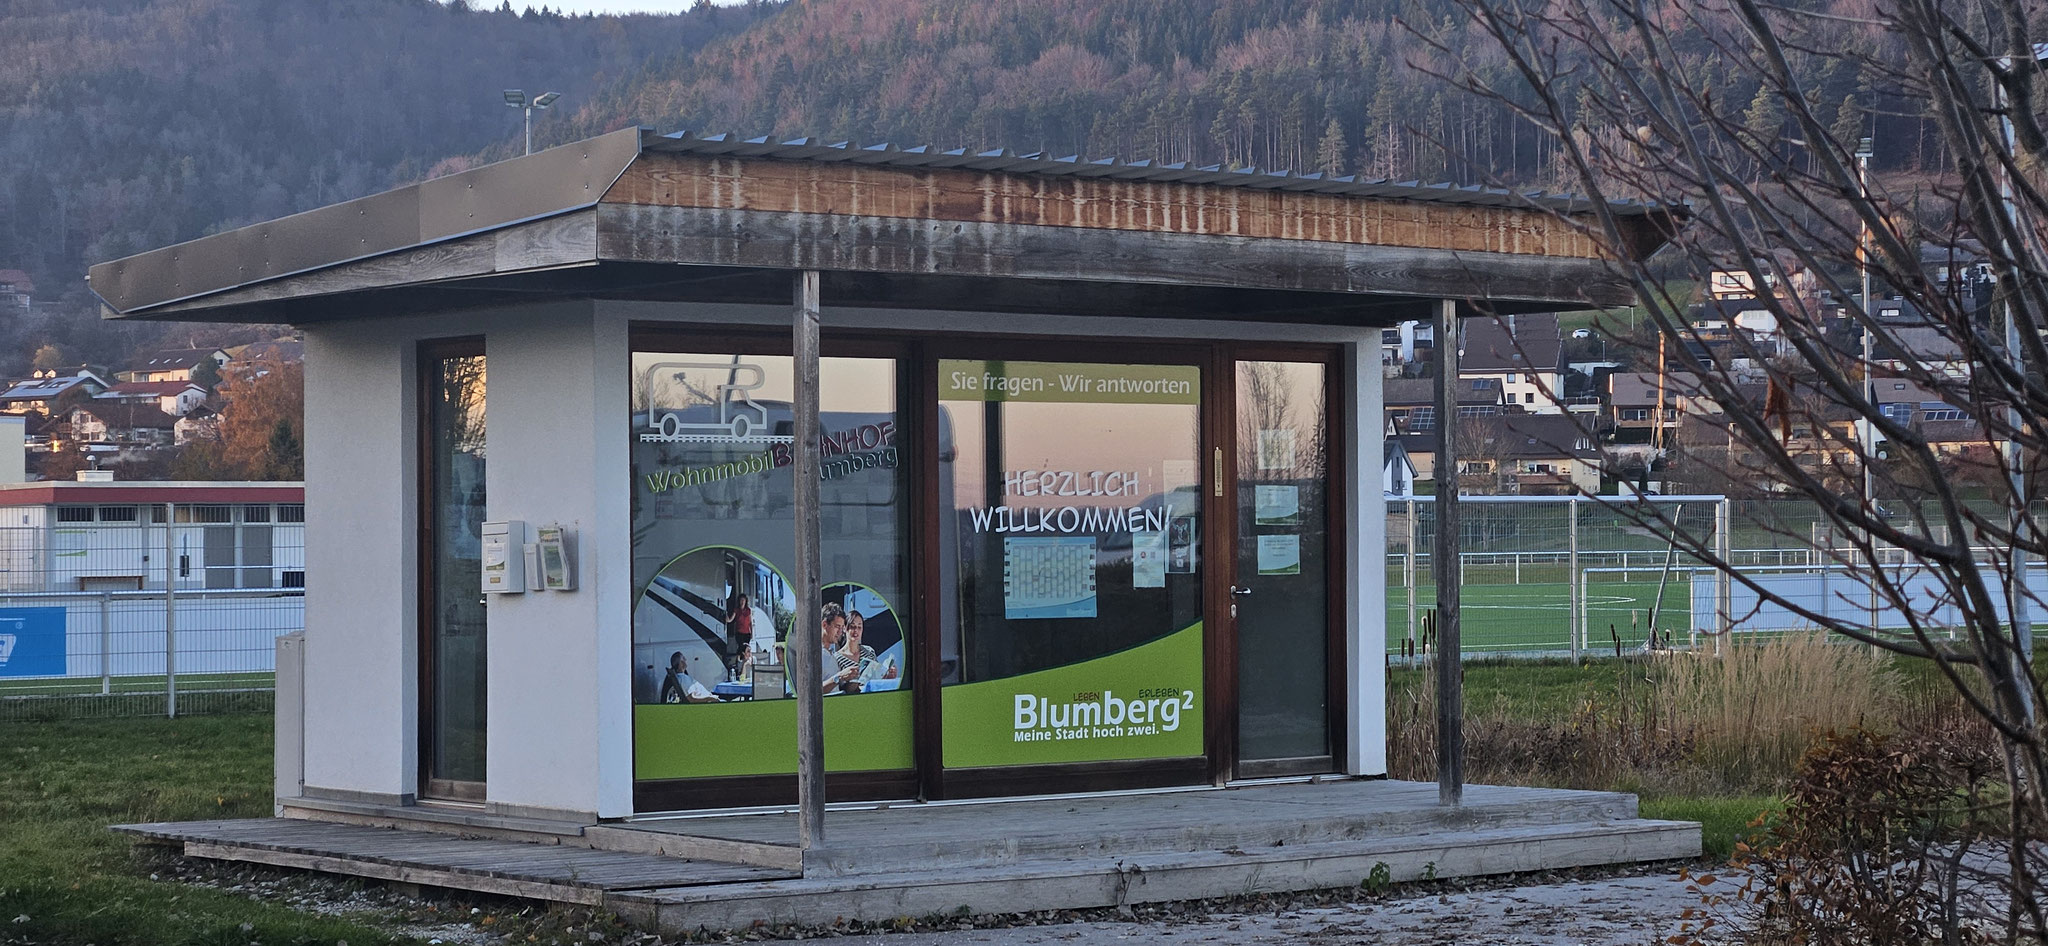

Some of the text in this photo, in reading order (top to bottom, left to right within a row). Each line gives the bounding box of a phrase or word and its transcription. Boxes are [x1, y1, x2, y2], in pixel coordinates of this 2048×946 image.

[951, 371, 978, 390] Sie
[983, 372, 1044, 396] fragen
[1058, 374, 1092, 392] Wir
[1096, 377, 1190, 395] antworten
[1004, 470, 1139, 497] HERZLICH
[970, 504, 1173, 533] WILLKOMMEN!
[1073, 692, 1100, 702] LEBEN
[1138, 688, 1180, 698] ERLEBEN
[1014, 723, 1160, 742] Meine Stadt hoch zwei.
